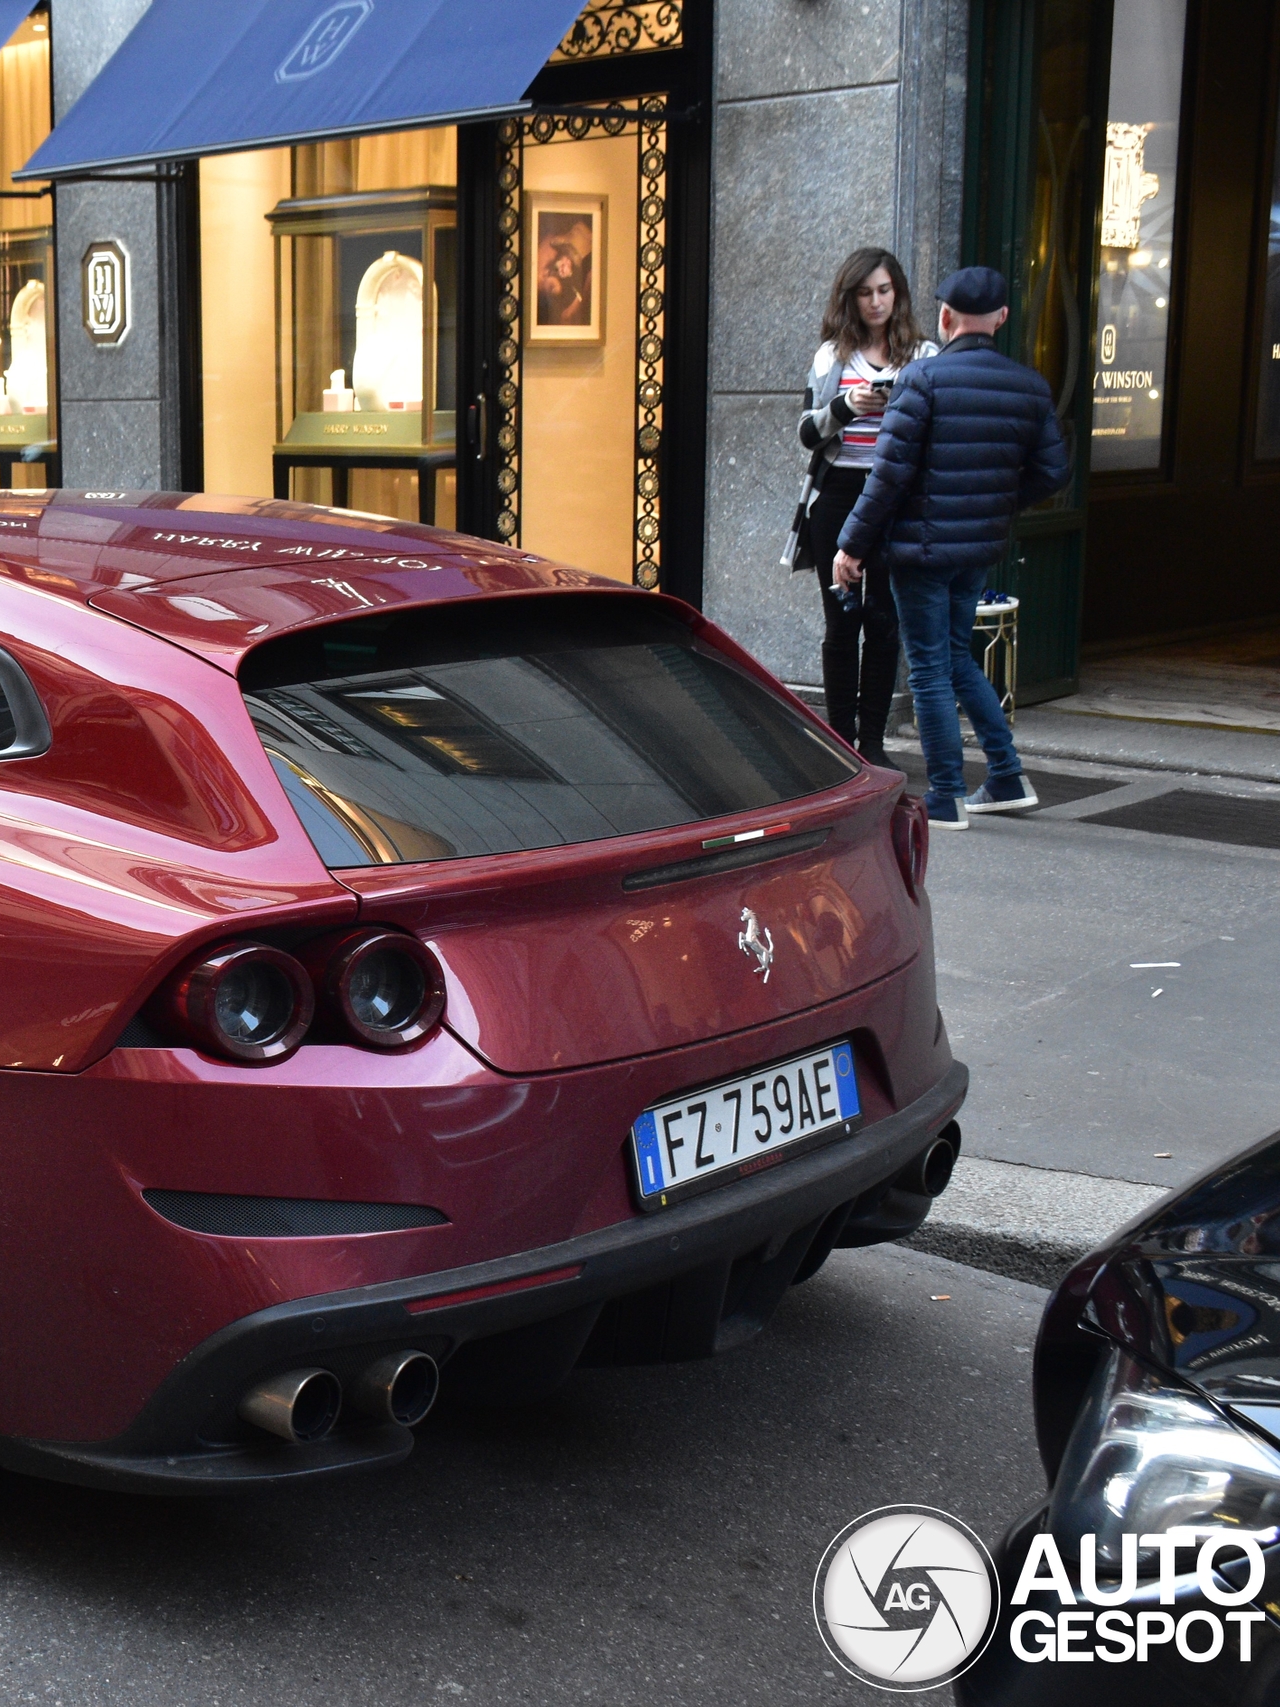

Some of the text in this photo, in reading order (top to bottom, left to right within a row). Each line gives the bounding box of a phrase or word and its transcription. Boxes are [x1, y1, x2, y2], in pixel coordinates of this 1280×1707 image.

[1101, 370, 1153, 389] WINSTON
[662, 1058, 837, 1178] FZ 759AE
